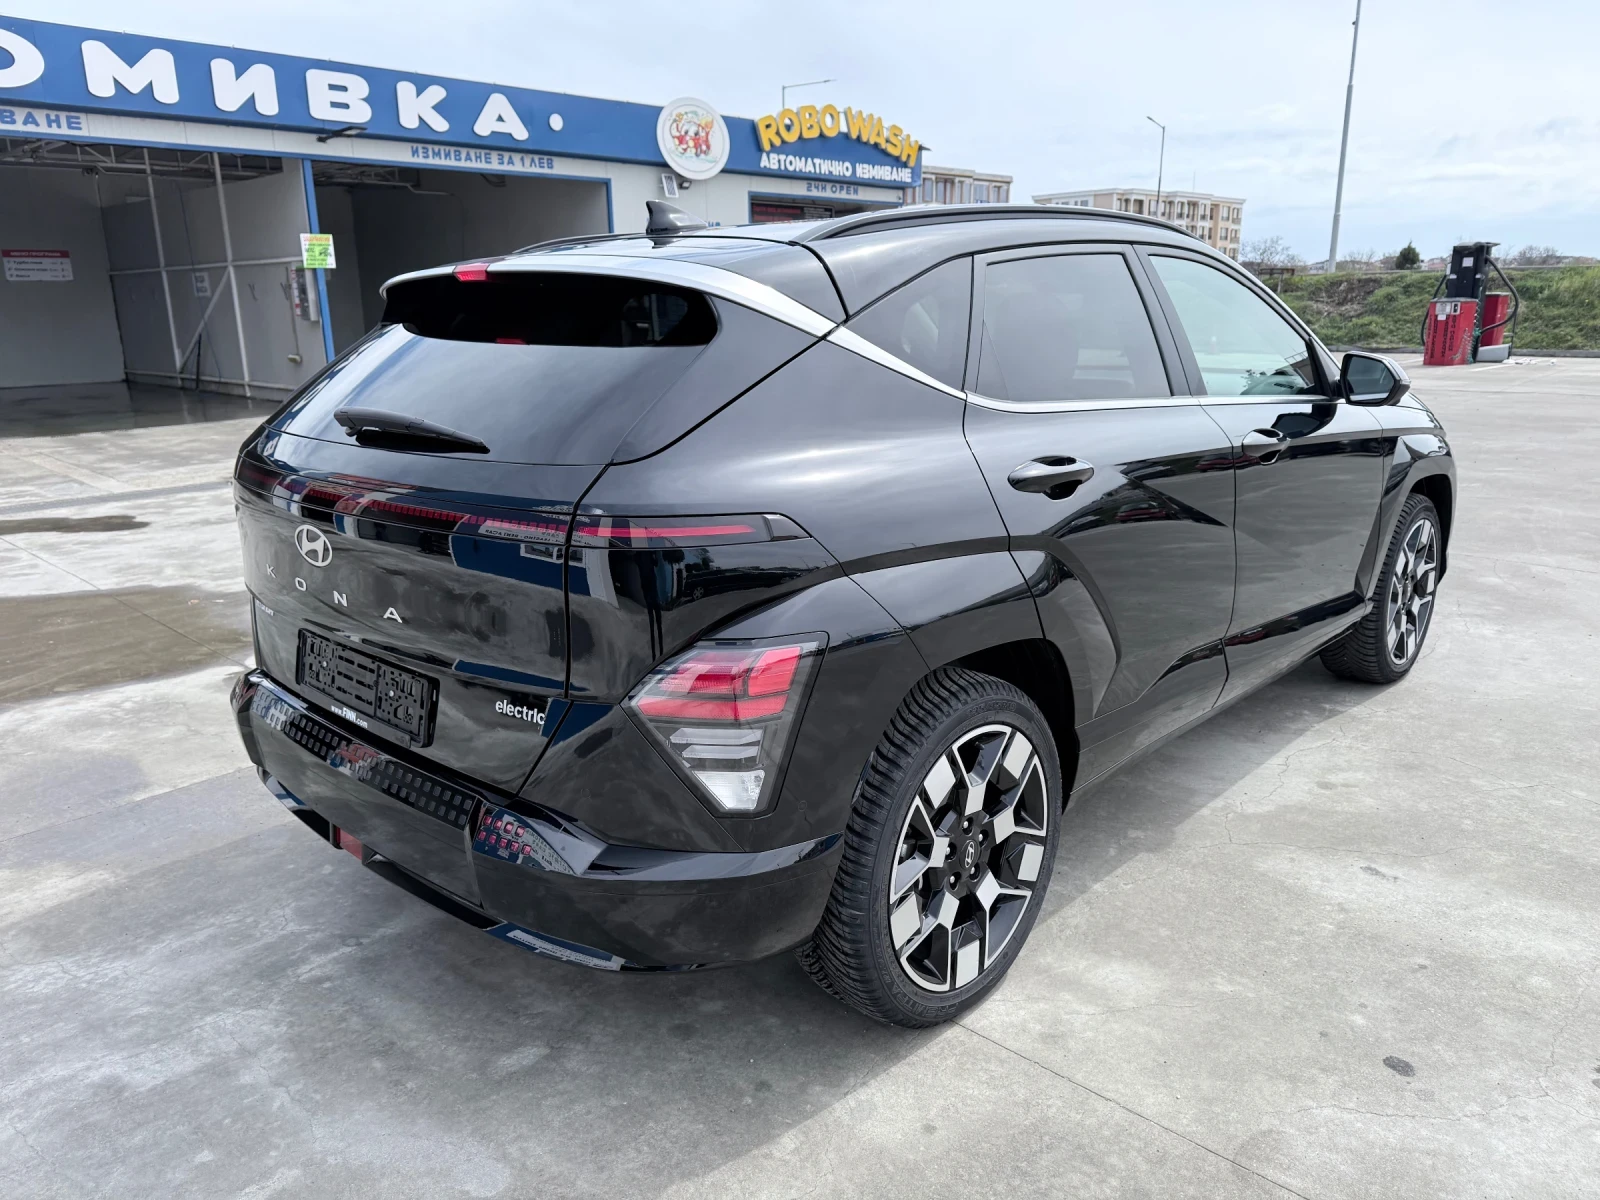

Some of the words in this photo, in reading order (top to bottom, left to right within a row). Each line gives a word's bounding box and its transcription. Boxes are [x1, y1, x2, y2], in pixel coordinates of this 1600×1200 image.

[757, 104, 840, 151] ROBO
[845, 106, 920, 167] WASH
[411, 145, 492, 164] ИЗМИВАНЕ
[497, 153, 515, 167] ЗА
[520, 157, 526, 168] 1
[529, 157, 555, 169] ЛЕВ
[760, 152, 852, 177] АВТОМАТИЧНО
[855, 162, 912, 182] ИЗМИВАНЕ
[830, 184, 859, 196] OPEN
[266, 563, 403, 624] KONA
[331, 704, 368, 729] www.FINN.com
[495, 699, 546, 725] electric
